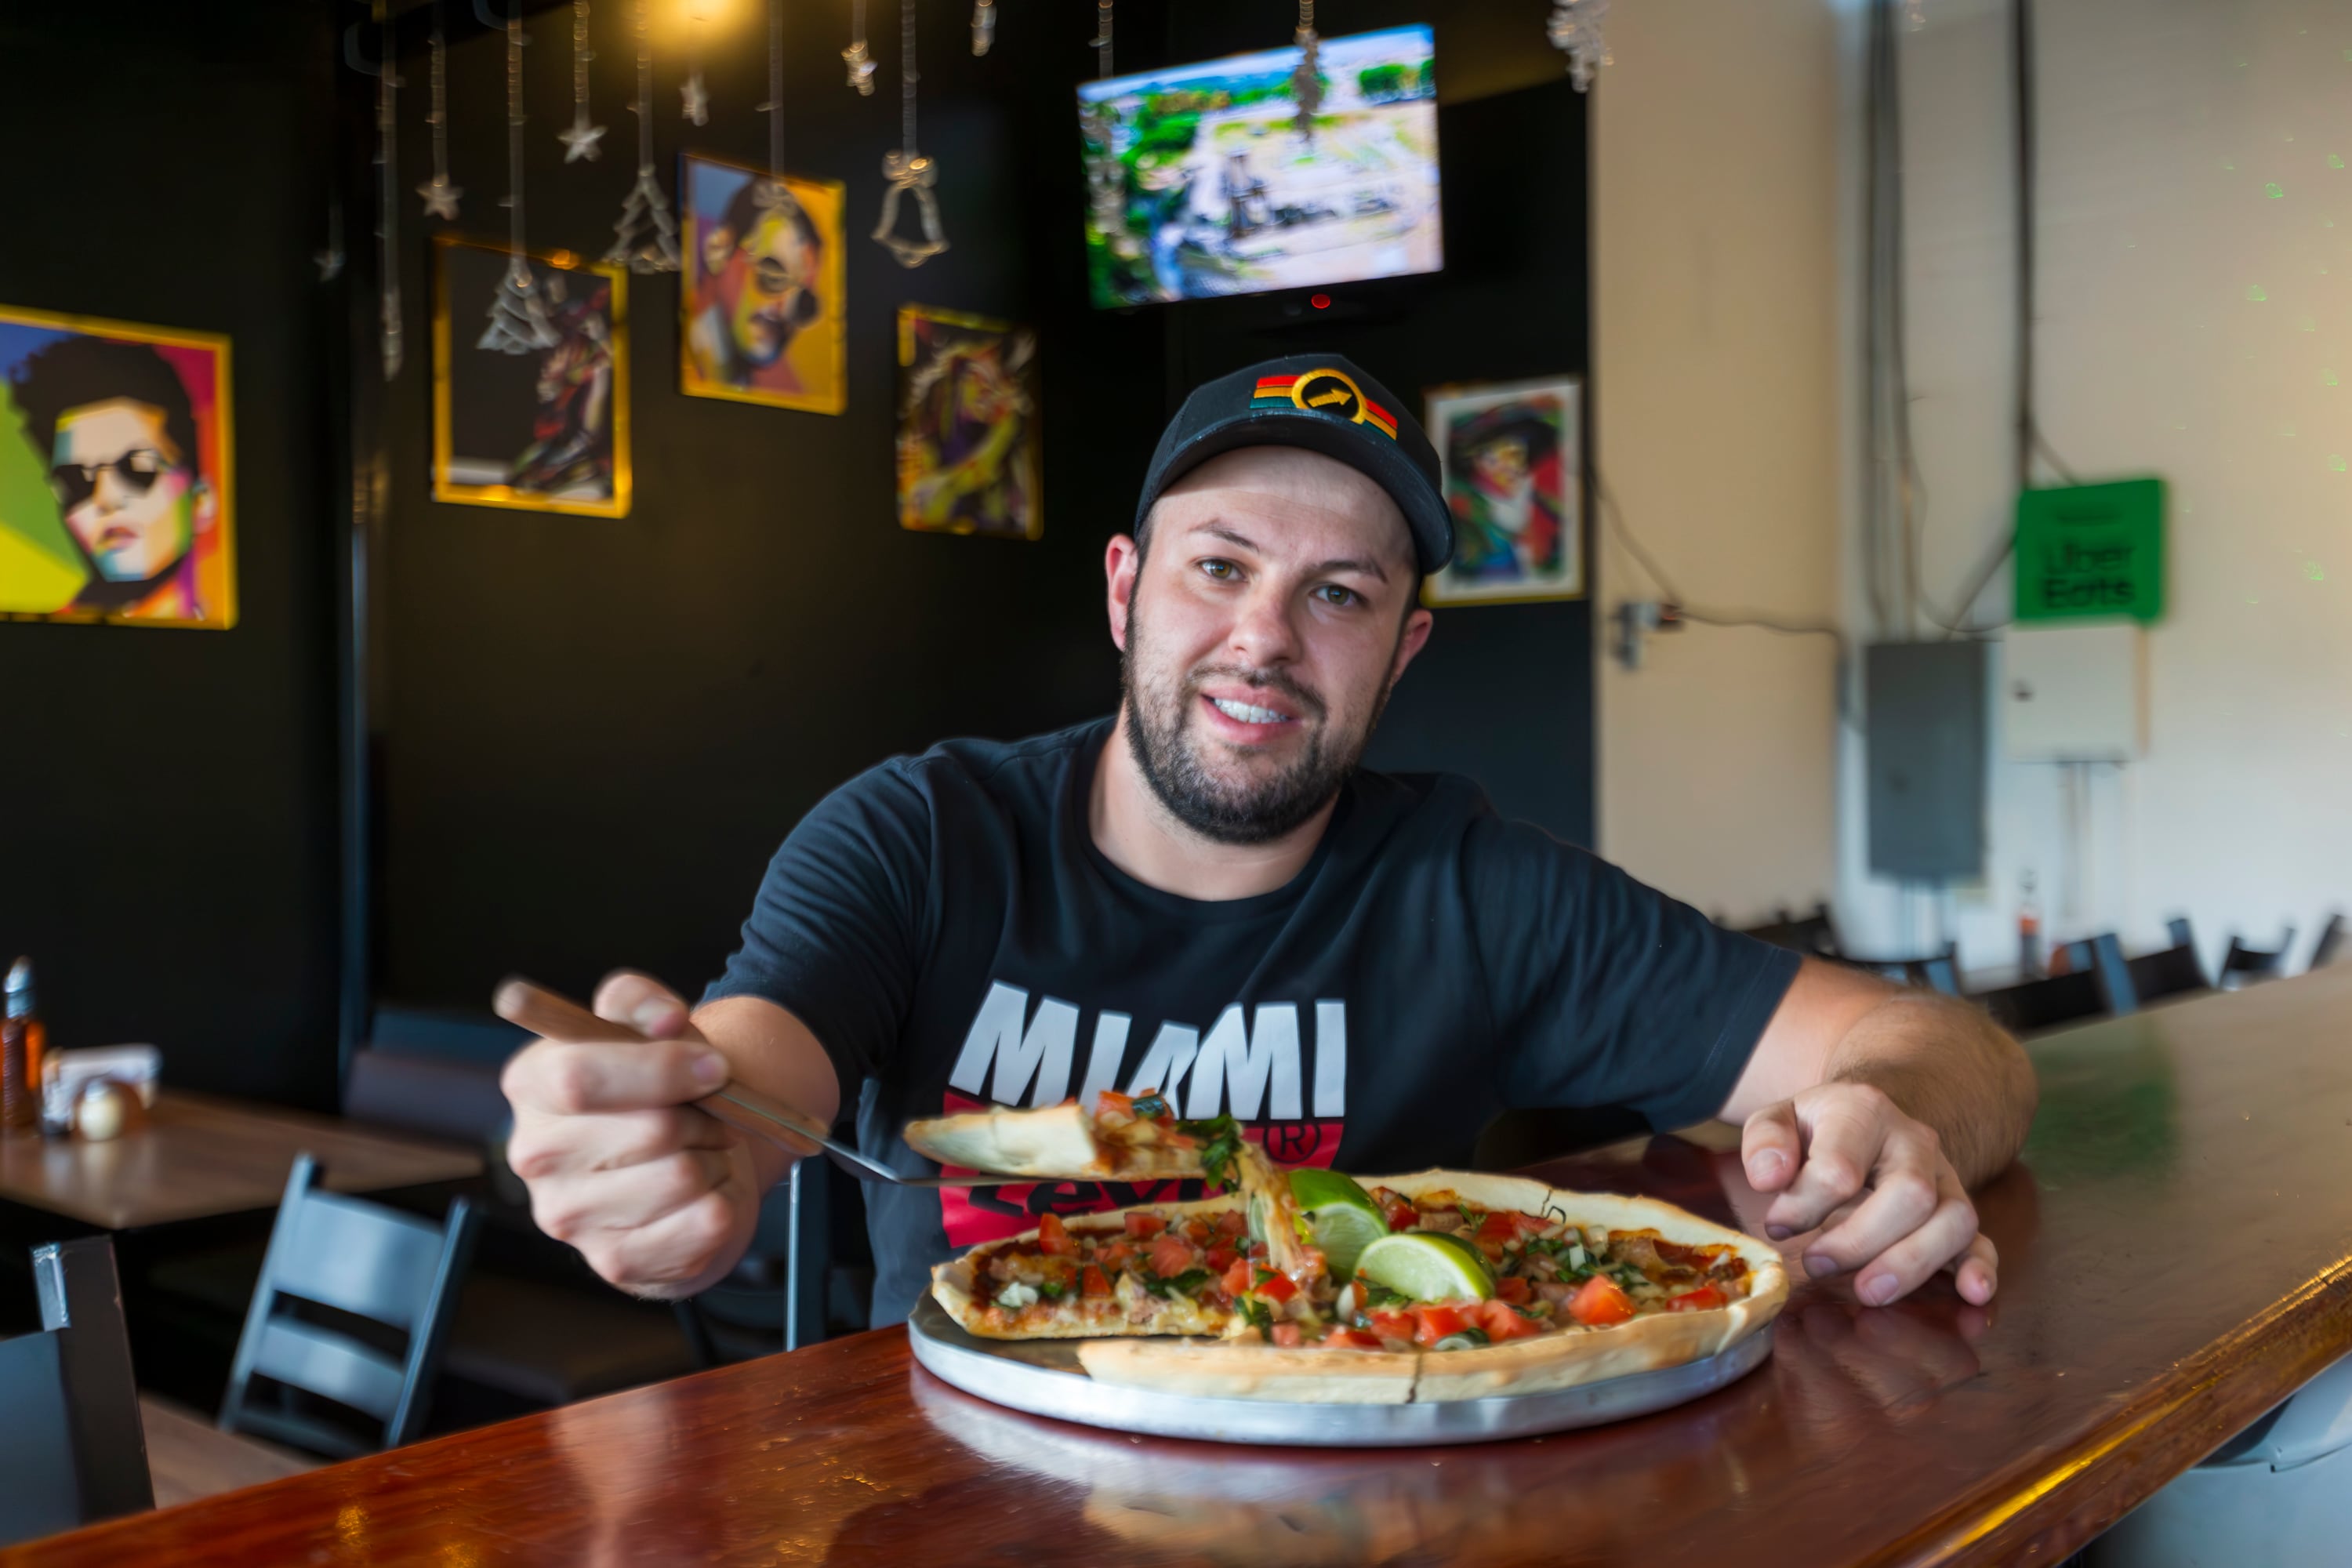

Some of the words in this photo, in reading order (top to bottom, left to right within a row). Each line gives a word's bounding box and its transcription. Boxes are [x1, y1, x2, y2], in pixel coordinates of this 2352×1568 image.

[2045, 541, 2134, 574] Uber
[2045, 577, 2134, 608] Eats
[949, 980, 1346, 1120] MIAMI
